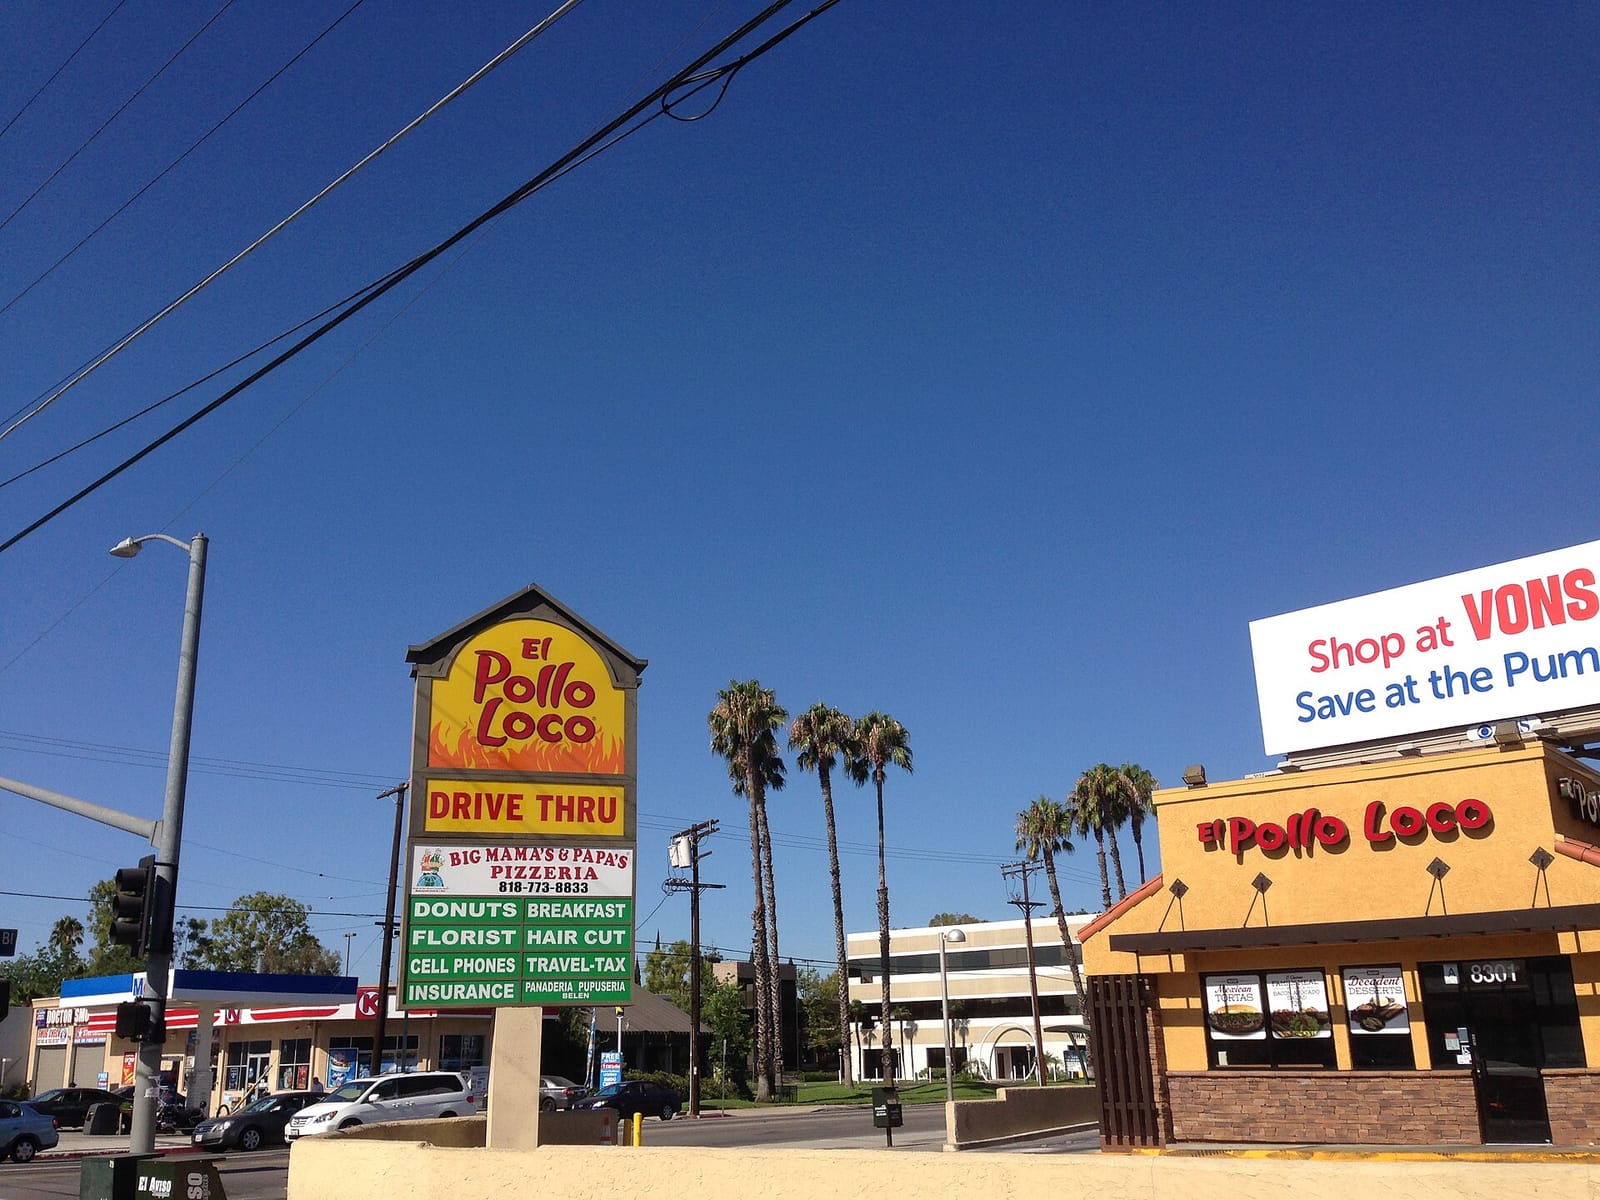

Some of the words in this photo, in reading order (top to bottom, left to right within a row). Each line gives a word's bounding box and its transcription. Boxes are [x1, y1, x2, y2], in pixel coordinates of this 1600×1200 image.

[1308, 633, 1405, 673] Shop
[1416, 616, 1454, 652] at
[1461, 568, 1599, 641] VONS
[521, 637, 552, 660] El
[473, 650, 595, 708] Pollo
[1296, 690, 1376, 723] Save
[1385, 675, 1421, 708] at
[1428, 665, 1494, 699] the
[477, 697, 595, 747] Loco
[429, 791, 524, 821] DRIVE
[536, 794, 617, 823] THRU
[1197, 818, 1221, 842] El
[1227, 808, 1345, 856] Pollo
[1364, 799, 1490, 842] Loco
[449, 849, 481, 867] BIG
[486, 847, 554, 862] MAMA'S
[558, 848, 569, 861] &
[573, 848, 628, 869] PAPA'S
[491, 866, 598, 880] PIZZERIA
[499, 881, 588, 893] 818-773-8833
[414, 902, 517, 917] DONUTS
[527, 903, 626, 918] BREAKFAST
[412, 930, 517, 945] FLORIST
[527, 930, 578, 945] HAIR
[584, 930, 626, 945] CUT
[410, 958, 449, 974] CELL
[453, 957, 515, 973] PHONES
[526, 957, 626, 972] TRAVEL-TAX
[1348, 975, 1400, 986] Decadent
[1471, 964, 1517, 983] 8301
[408, 983, 514, 1000] INSURANCE
[525, 981, 573, 992] PANADERIA
[578, 981, 626, 992] PUPUSERIA
[1348, 986, 1402, 995] DESSERTS
[1214, 993, 1254, 1002] TORTAS
[46, 1008, 73, 1024] DOCTOR
